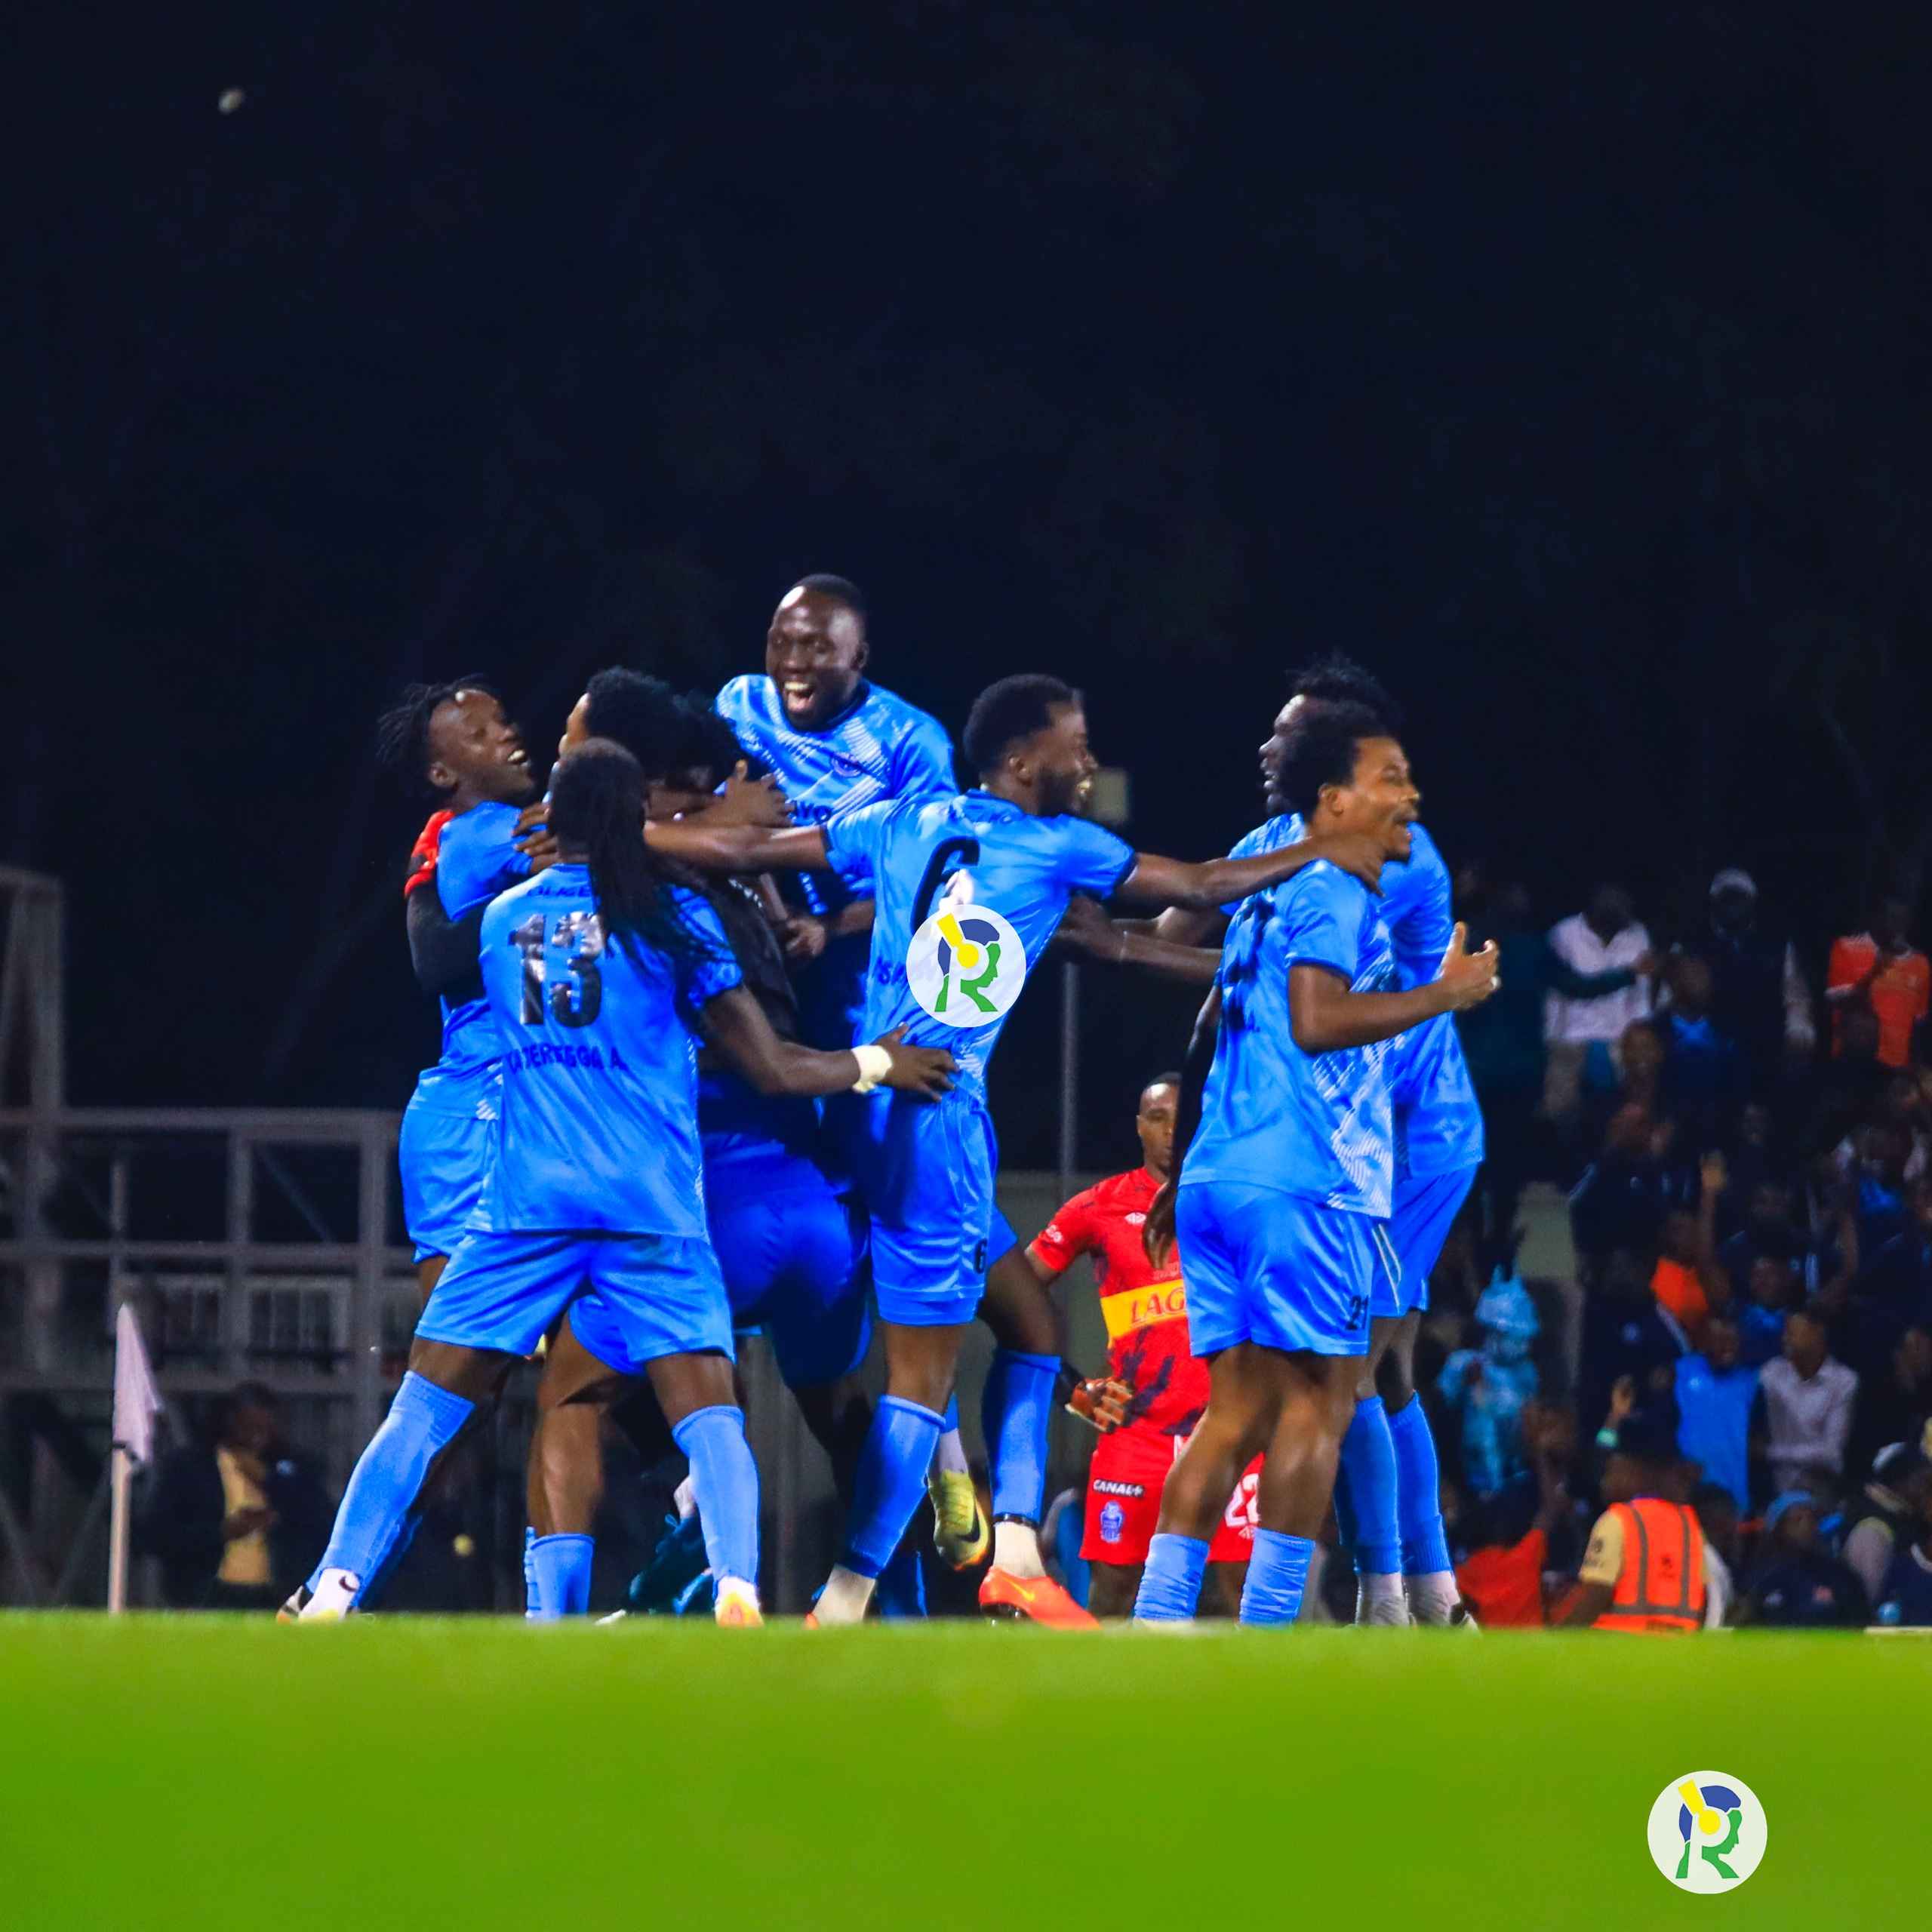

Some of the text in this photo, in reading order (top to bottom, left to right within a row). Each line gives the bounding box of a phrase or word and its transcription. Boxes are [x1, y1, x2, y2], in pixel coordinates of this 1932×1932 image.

[508, 911, 605, 1029] 13
[974, 1238, 987, 1274] 6
[1346, 1295, 1368, 1331] 21
[1093, 1479, 1144, 1497] CANAL+
